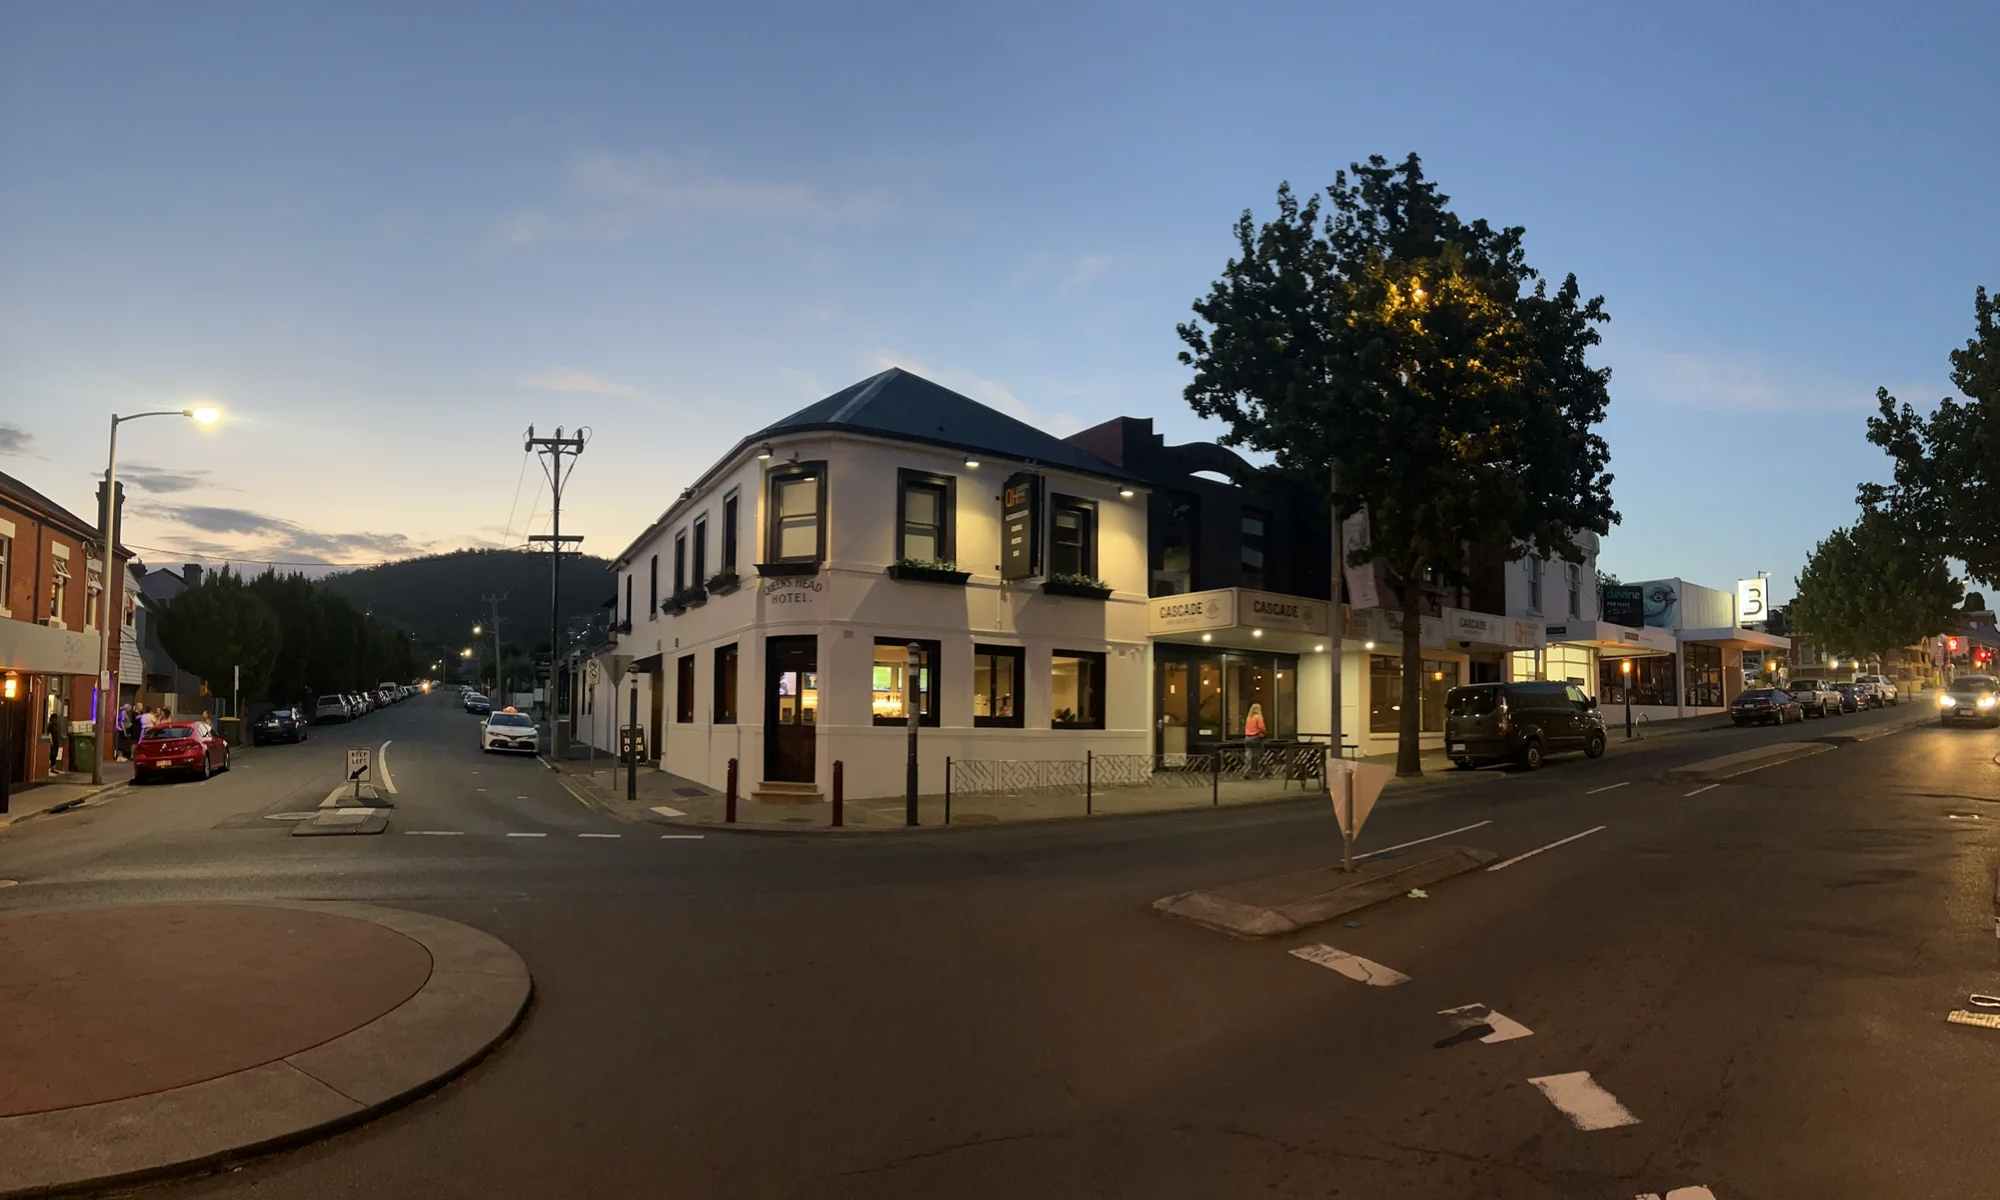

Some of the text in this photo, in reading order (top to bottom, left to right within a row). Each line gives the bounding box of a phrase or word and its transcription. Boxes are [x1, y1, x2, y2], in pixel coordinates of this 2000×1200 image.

[795, 577, 823, 593] HEAD
[1606, 589, 1641, 600] devine
[1160, 602, 1203, 619] CASCADE
[1253, 600, 1299, 618] CASCADE
